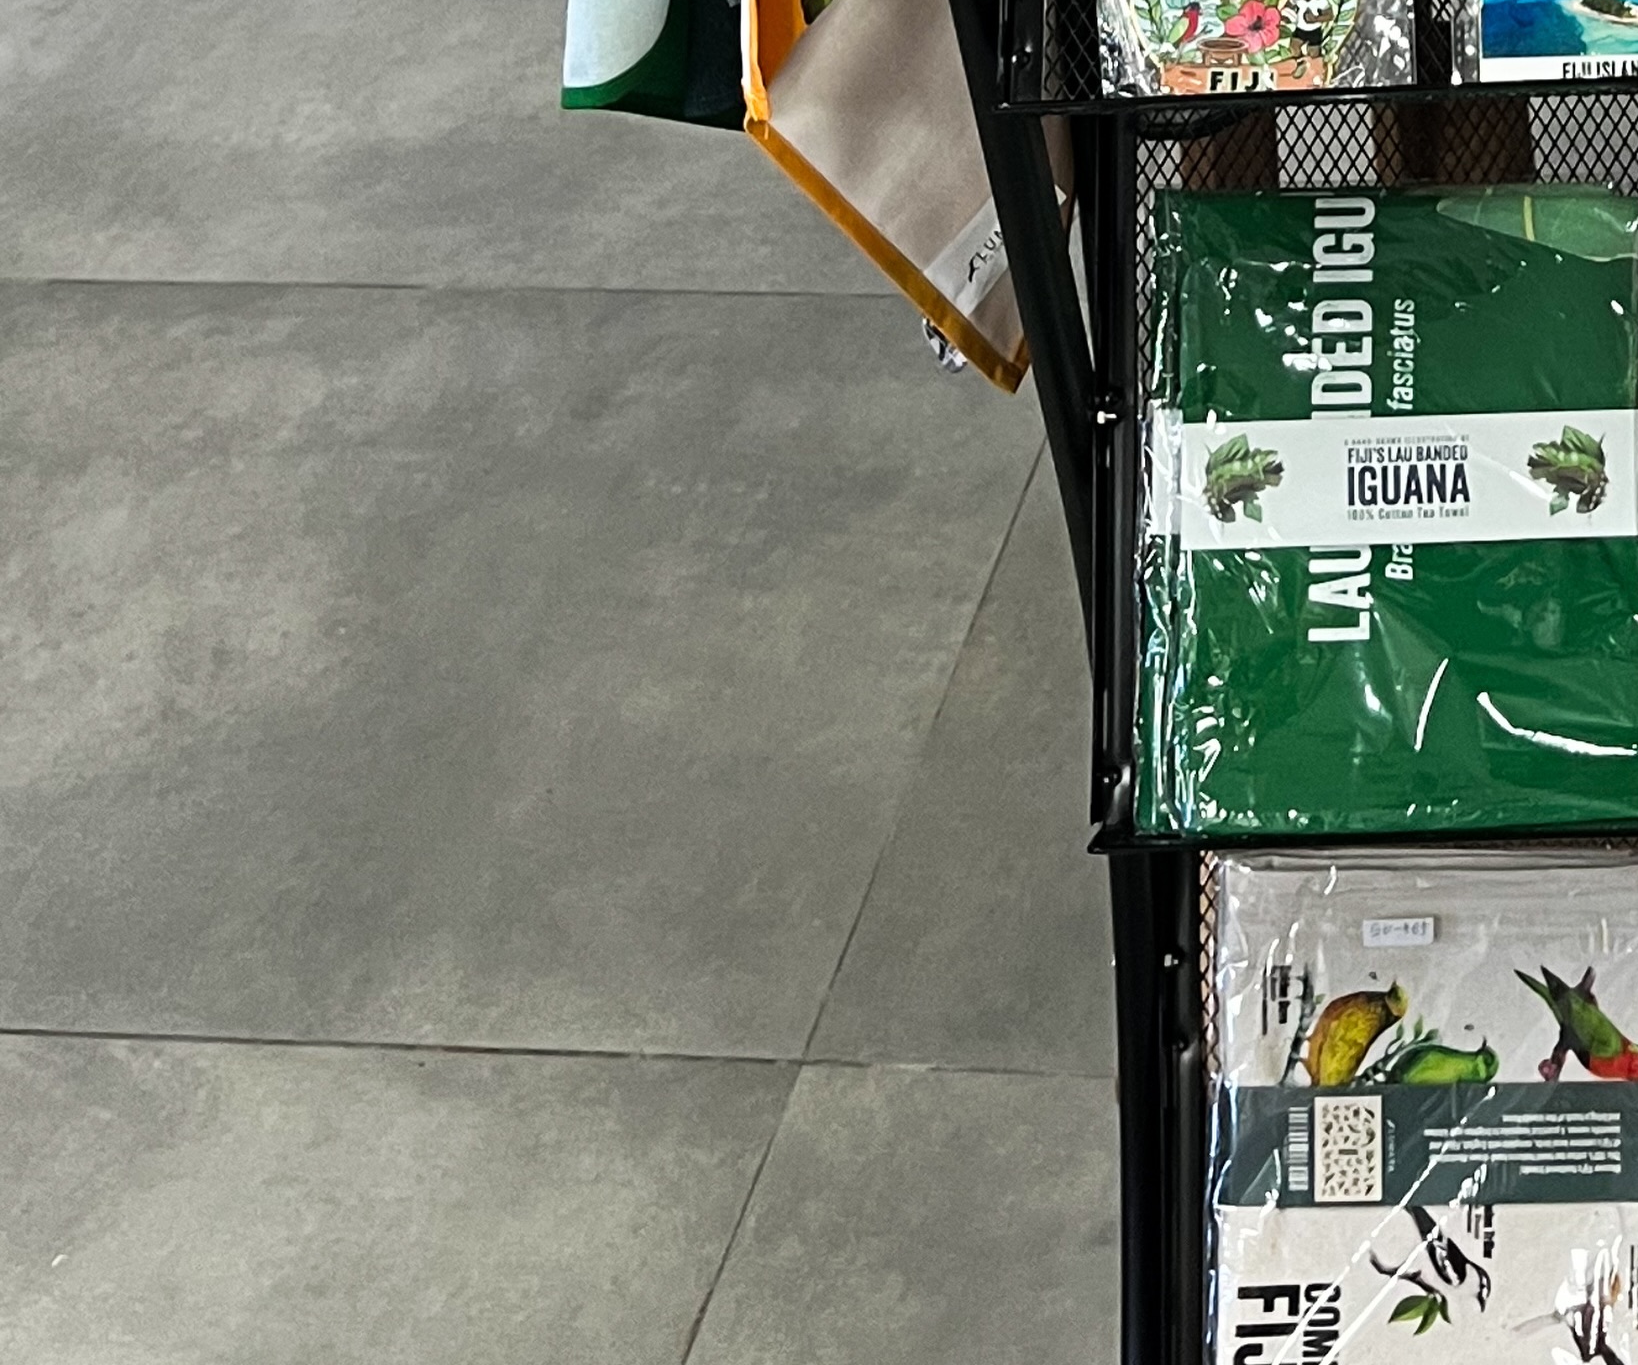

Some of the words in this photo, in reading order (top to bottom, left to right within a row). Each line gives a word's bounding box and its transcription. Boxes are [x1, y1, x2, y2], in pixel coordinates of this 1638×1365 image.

[1312, 197, 1376, 283] IGU
[1387, 299, 1415, 410] fasciatus
[1347, 463, 1470, 506] IGUANA
[1348, 447, 1385, 464] FIJI'S
[1388, 447, 1412, 463] LAU
[1416, 445, 1468, 462] BANDED
[1308, 546, 1372, 642] LAU
